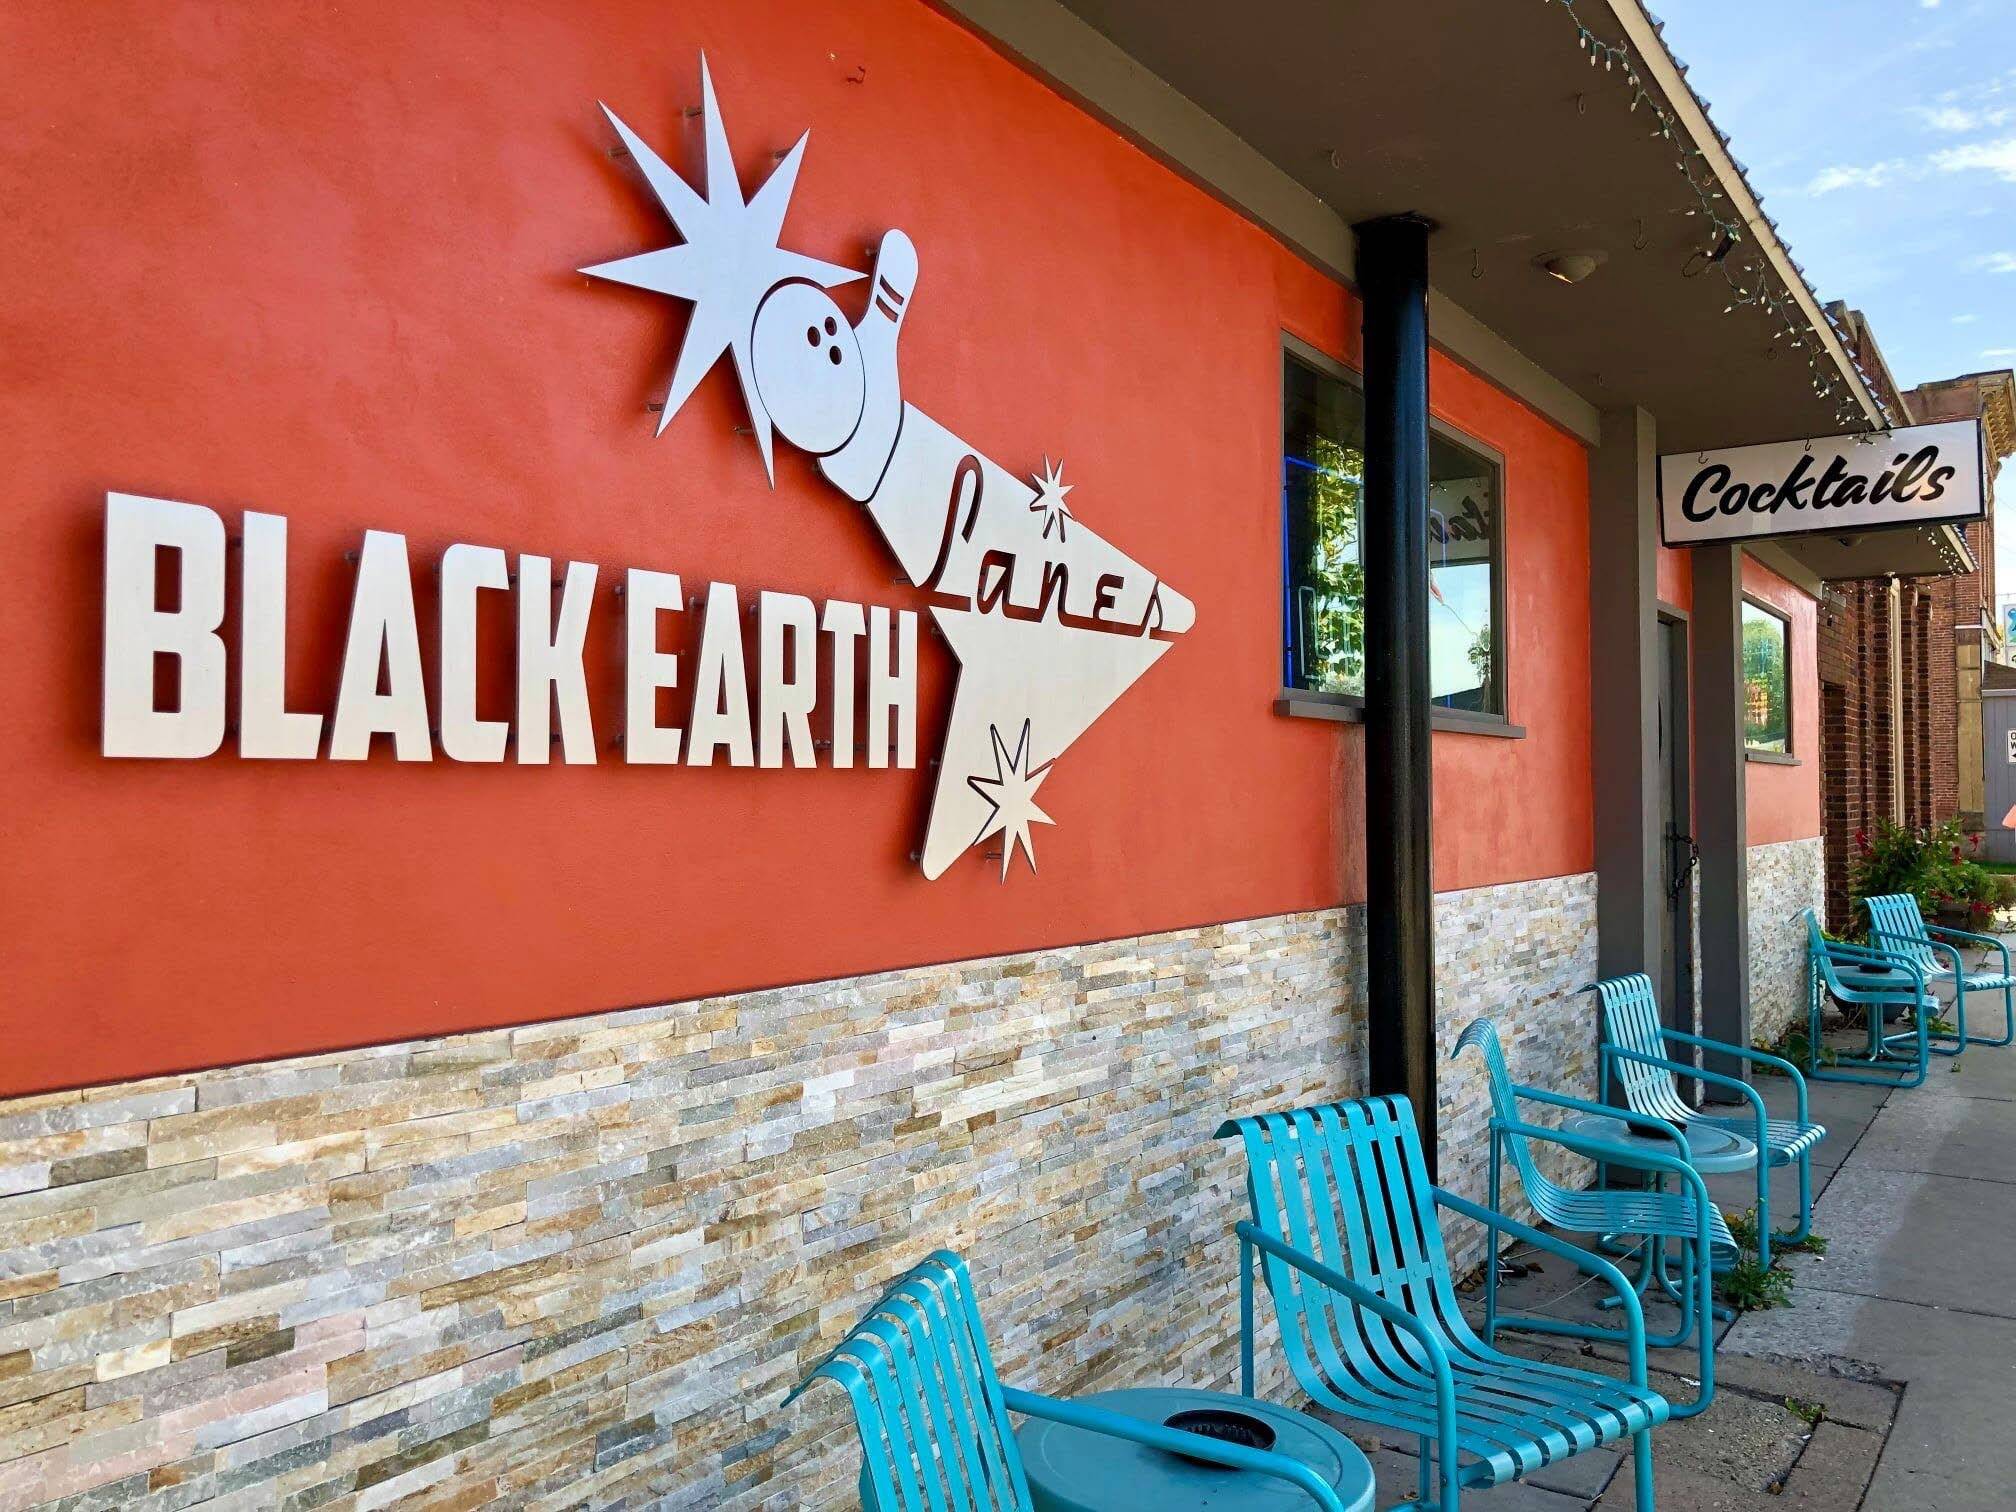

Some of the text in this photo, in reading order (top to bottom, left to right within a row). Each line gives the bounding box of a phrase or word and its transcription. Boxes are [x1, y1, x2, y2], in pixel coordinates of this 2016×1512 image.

[914, 454, 1174, 642] Lanes
[1682, 445, 1955, 522] Cocktails
[102, 490, 918, 769] BLACK EARTH
